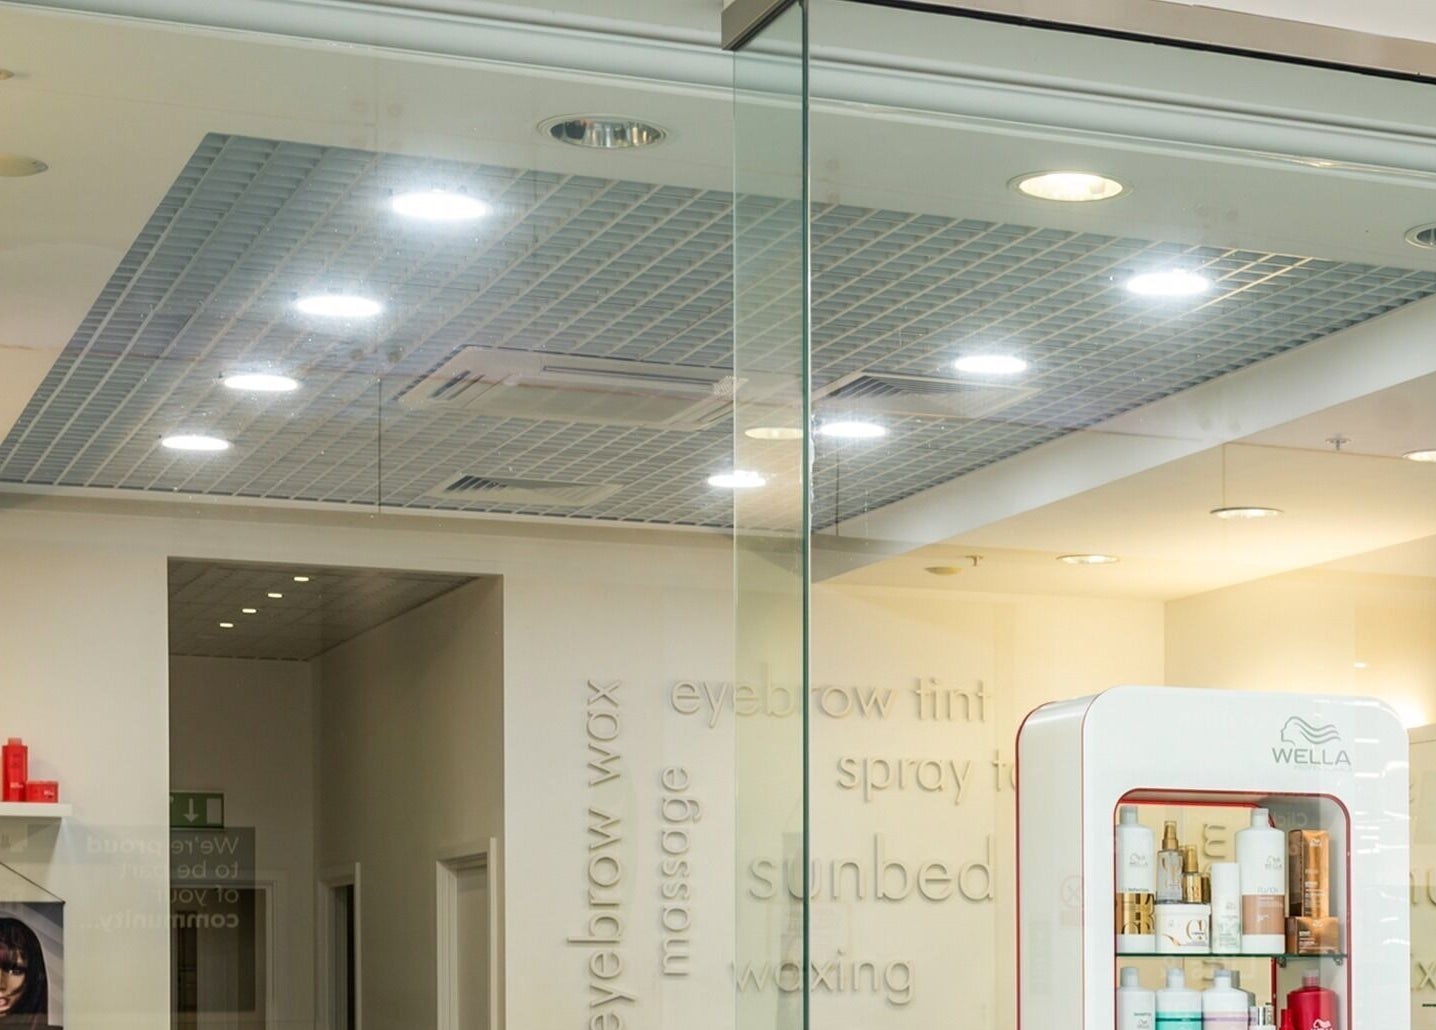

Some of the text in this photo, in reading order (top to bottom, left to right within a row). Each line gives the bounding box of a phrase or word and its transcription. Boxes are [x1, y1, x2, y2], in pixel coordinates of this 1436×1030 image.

[669, 664, 989, 728] eyebrow tint
[586, 680, 622, 788] wax
[1271, 747, 1351, 766] WELLA
[837, 754, 972, 804] spray
[659, 765, 700, 979] massage
[748, 834, 993, 903] sunbed
[730, 949, 914, 1006] waxing
